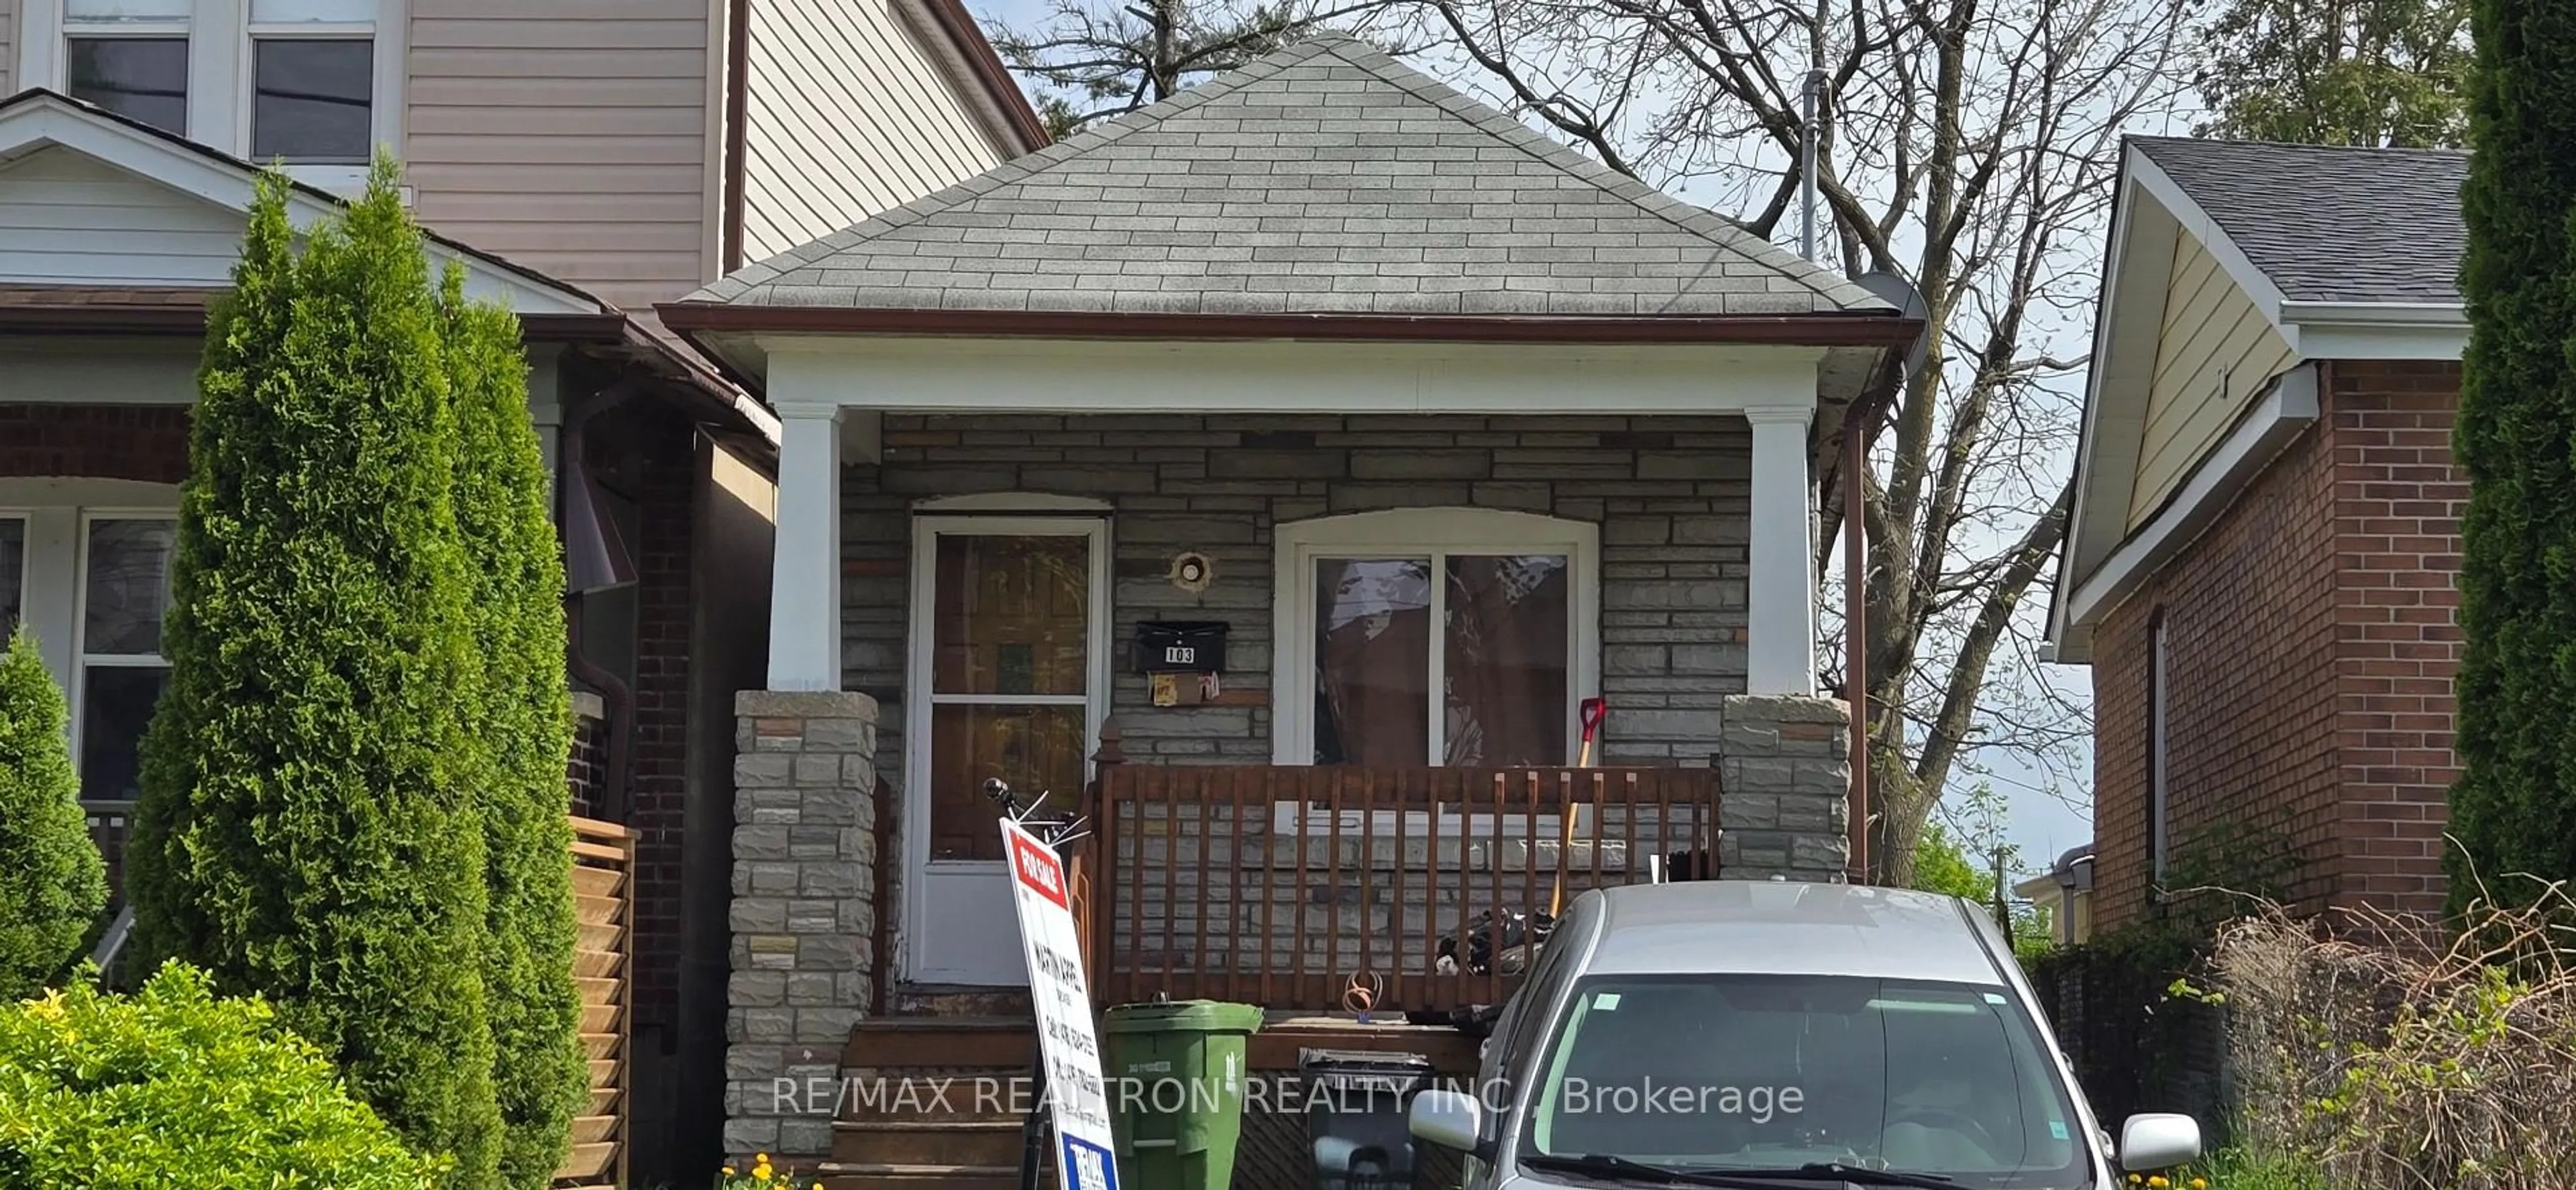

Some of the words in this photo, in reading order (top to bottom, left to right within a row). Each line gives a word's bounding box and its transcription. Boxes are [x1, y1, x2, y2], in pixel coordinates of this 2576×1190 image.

[1169, 649, 1192, 661] 103
[1020, 846, 1039, 882] FOR
[1036, 857, 1059, 894] SALE
